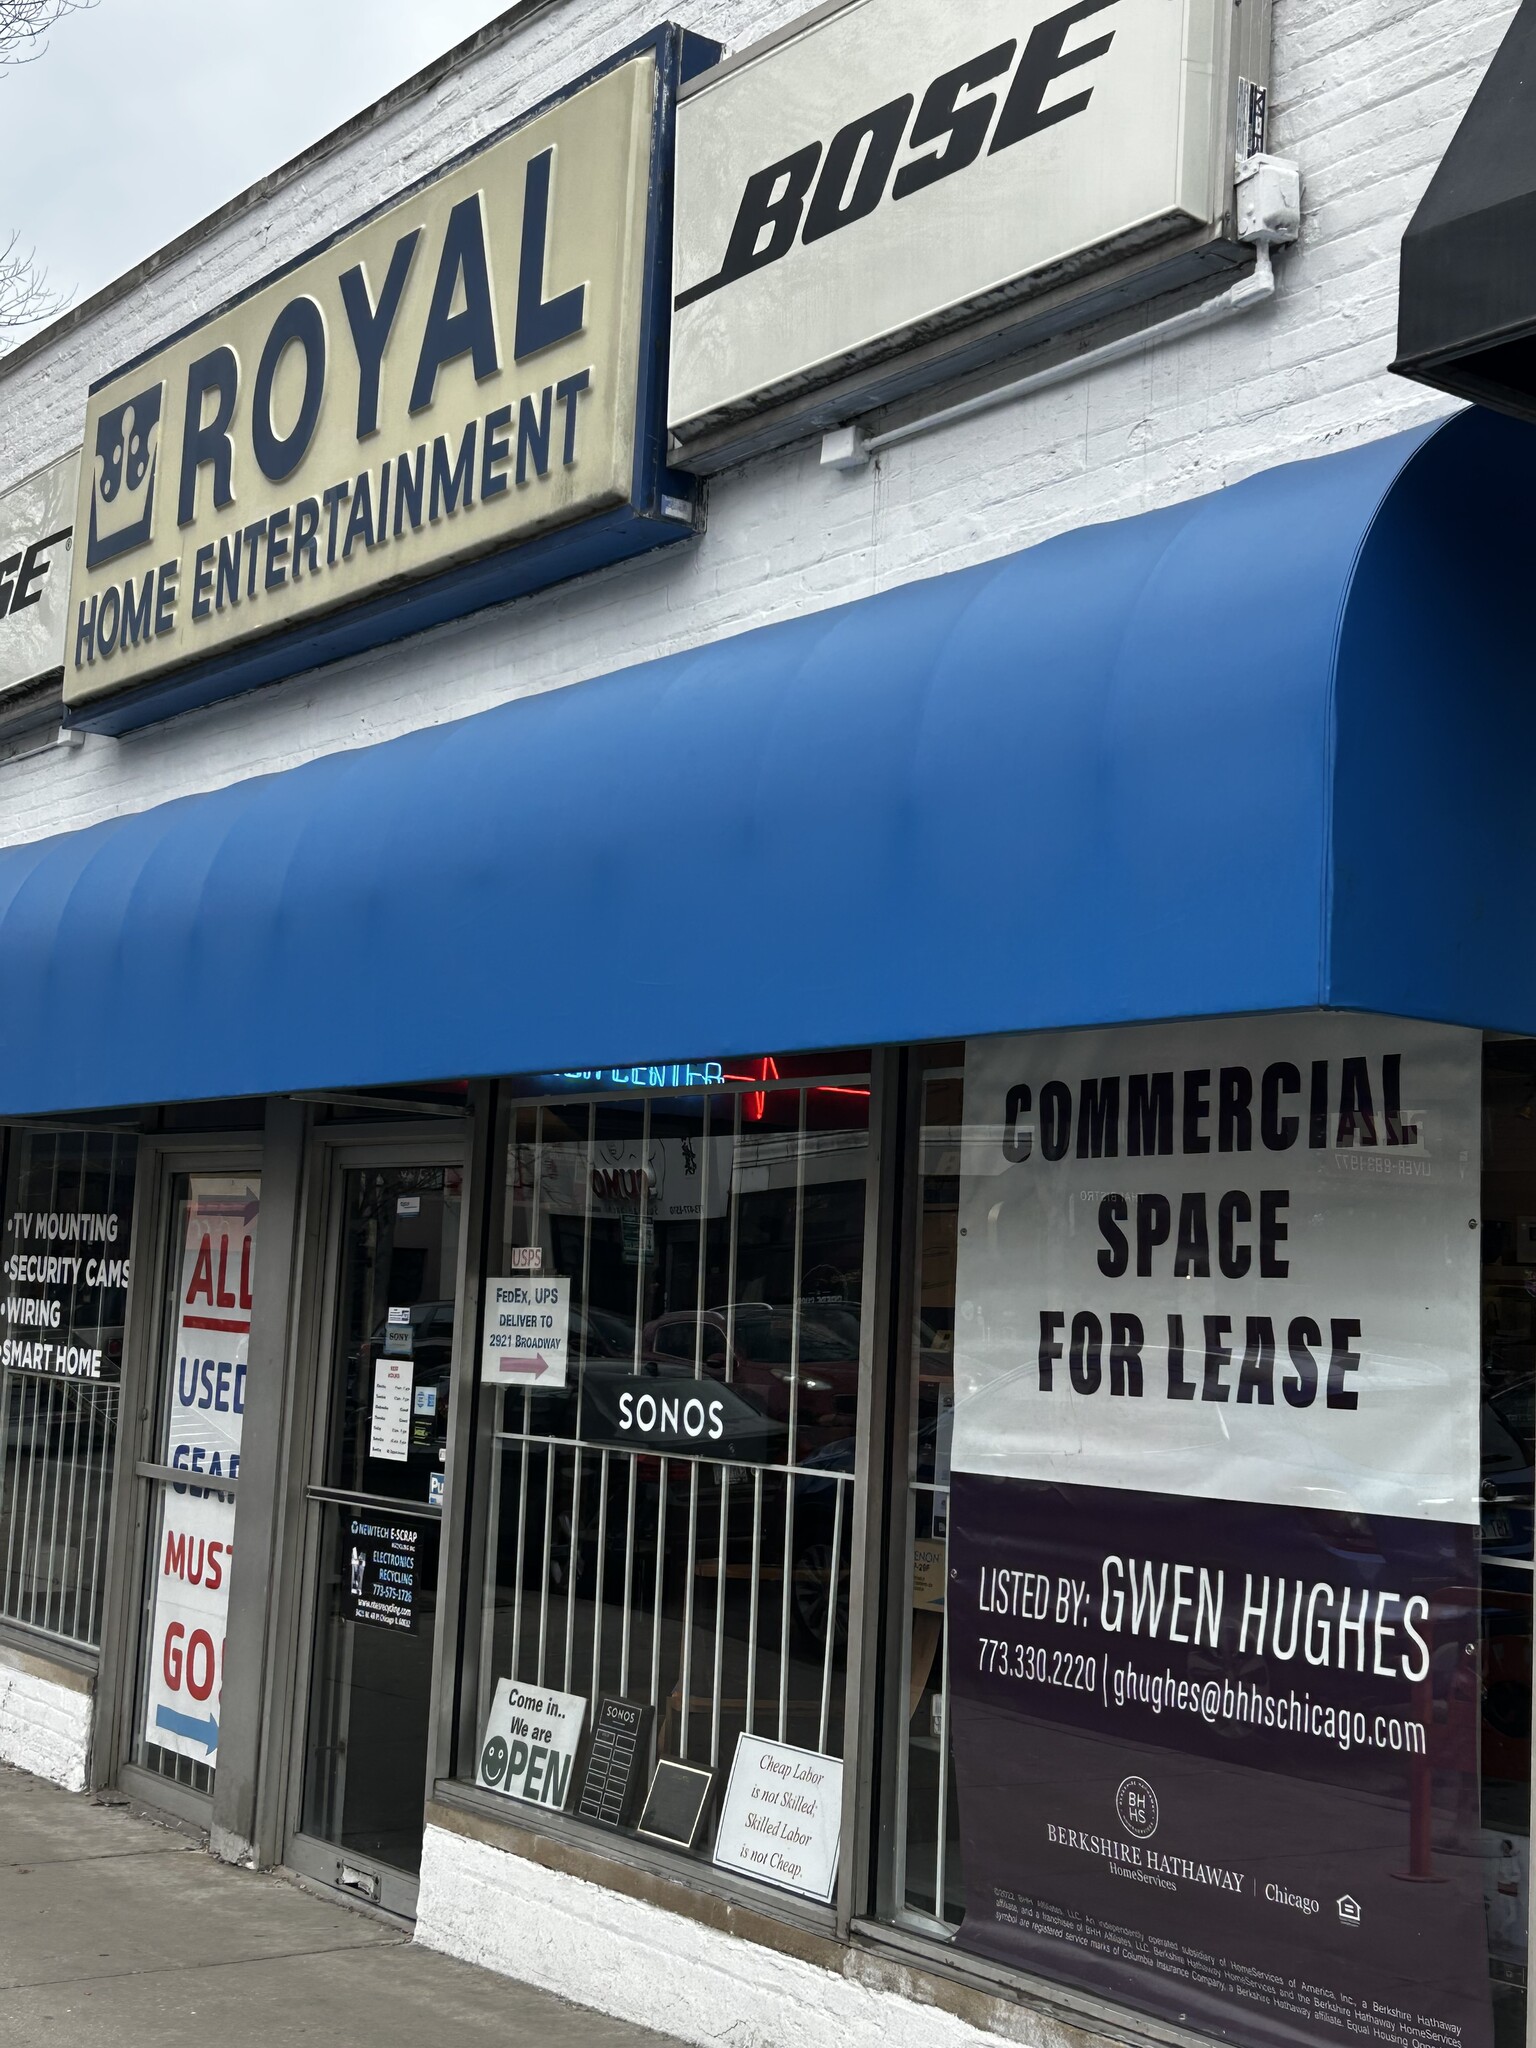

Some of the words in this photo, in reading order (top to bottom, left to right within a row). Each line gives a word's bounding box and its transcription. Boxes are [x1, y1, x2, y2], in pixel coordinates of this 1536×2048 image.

[714, 0, 1118, 278] BOSE
[177, 147, 587, 528] ROYAL
[75, 561, 179, 667] HOME
[191, 368, 592, 622] ENTERTAINMENT
[0, 525, 73, 619] SE
[1004, 1053, 1418, 1164] COMMERCIAL
[14, 1212, 32, 1239] TV
[35, 1213, 119, 1242] MOUNTING
[1097, 1190, 1290, 1279] SPACE
[8, 1255, 82, 1285] SECURITY
[85, 1258, 130, 1288] CAMS
[185, 1233, 252, 1309] ALL
[512, 1249, 541, 1267] USPS
[7, 1297, 61, 1328] WIRING
[535, 1287, 559, 1304] UPS
[389, 1332, 409, 1341] SONY
[499, 1314, 537, 1328] DELIVER
[540, 1315, 553, 1328] TO
[2, 1339, 53, 1371] SMART
[55, 1346, 102, 1378] HOME
[489, 1334, 512, 1347] 2921
[515, 1335, 561, 1349] BROADWAY
[1039, 1311, 1145, 1397] FOR
[1167, 1314, 1362, 1410] LEASE
[178, 1357, 247, 1414] USED
[618, 1392, 724, 1440] SONOS
[359, 1523, 389, 1539] NEWTECH
[390, 1528, 418, 1543] E-SCRAP
[164, 1531, 233, 1590] MUS
[373, 1550, 415, 1569] ELECTRONICS
[914, 1551, 939, 1562] ENON
[379, 1568, 413, 1586] RECYCLING
[979, 1566, 1050, 1620] LISTED
[1055, 1577, 1090, 1628] BY:
[1100, 1555, 1225, 1648] GWEN
[1239, 1573, 1430, 1682] HUGHES
[508, 1688, 544, 1713] Come
[546, 1697, 566, 1719] in..
[979, 1637, 1096, 1692] 773.330.2220
[1114, 1661, 1426, 1755] ghughes@bhhschicago.com
[510, 1716, 529, 1737] We
[531, 1727, 552, 1743] are
[606, 1705, 635, 1723] SONOS
[759, 1754, 792, 1780] Cheap
[793, 1763, 825, 1785] Labor
[751, 1784, 761, 1799] is
[761, 1788, 780, 1804] not
[780, 1791, 818, 1818] Skilled;
[1128, 1791, 1146, 1809] BH
[1129, 1806, 1147, 1824] HS
[745, 1812, 781, 1837] Skilled
[780, 1823, 812, 1847] Labor
[740, 1843, 750, 1859] is
[750, 1850, 769, 1865] not
[769, 1852, 803, 1880] Cheap.
[1047, 1823, 1142, 1866] BERKSHIRE
[1146, 1850, 1245, 1893] HATHAWAY
[1265, 1883, 1319, 1915] Chicago
[1109, 1861, 1177, 1892] HomeServices
[995, 1910, 1018, 1922] symbol
[1019, 1918, 1030, 1928] are
[1032, 1921, 1063, 1938] registered
[1065, 1931, 1089, 1946] service
[1090, 1940, 1111, 1953] marks
[1113, 1946, 1120, 1955] of
[1122, 1948, 1153, 1967] Columbia
[1156, 1960, 1189, 1978] Insurance
[1228, 1984, 1234, 1992] a
[1236, 1985, 1271, 2005] Berkshire
[1273, 1996, 1311, 2019] Hathaway
[1346, 2020, 1370, 2035] Equal
[1373, 2028, 1408, 2048] Housing
[1020, 1906, 1034, 1917] and
[1076, 1923, 1083, 1932] of
[1153, 1946, 1185, 1965] Berkshire
[1187, 1957, 1221, 1978] Hathaway
[1224, 1970, 1276, 1995] HomeServices
[1279, 1988, 1294, 2000] and
[1297, 1993, 1311, 2005] the
[1314, 1997, 1351, 2017] Berkshire
[1354, 2009, 1396, 2032] Hathaway
[1399, 2022, 1462, 2048] HomeServices
[1085, 1914, 1096, 1926] An
[1148, 1935, 1179, 1951] operated
[1181, 1946, 1215, 1965] subsidiary
[1219, 1958, 1227, 1967] of
[1230, 1960, 1284, 1985] HomeServices
[1288, 1978, 1297, 1988] of
[1301, 1981, 1336, 2000] America,
[1361, 2000, 1368, 2009] a
[1372, 2001, 1412, 2022] Berkshire
[1417, 2014, 1462, 2037] Hathaway
